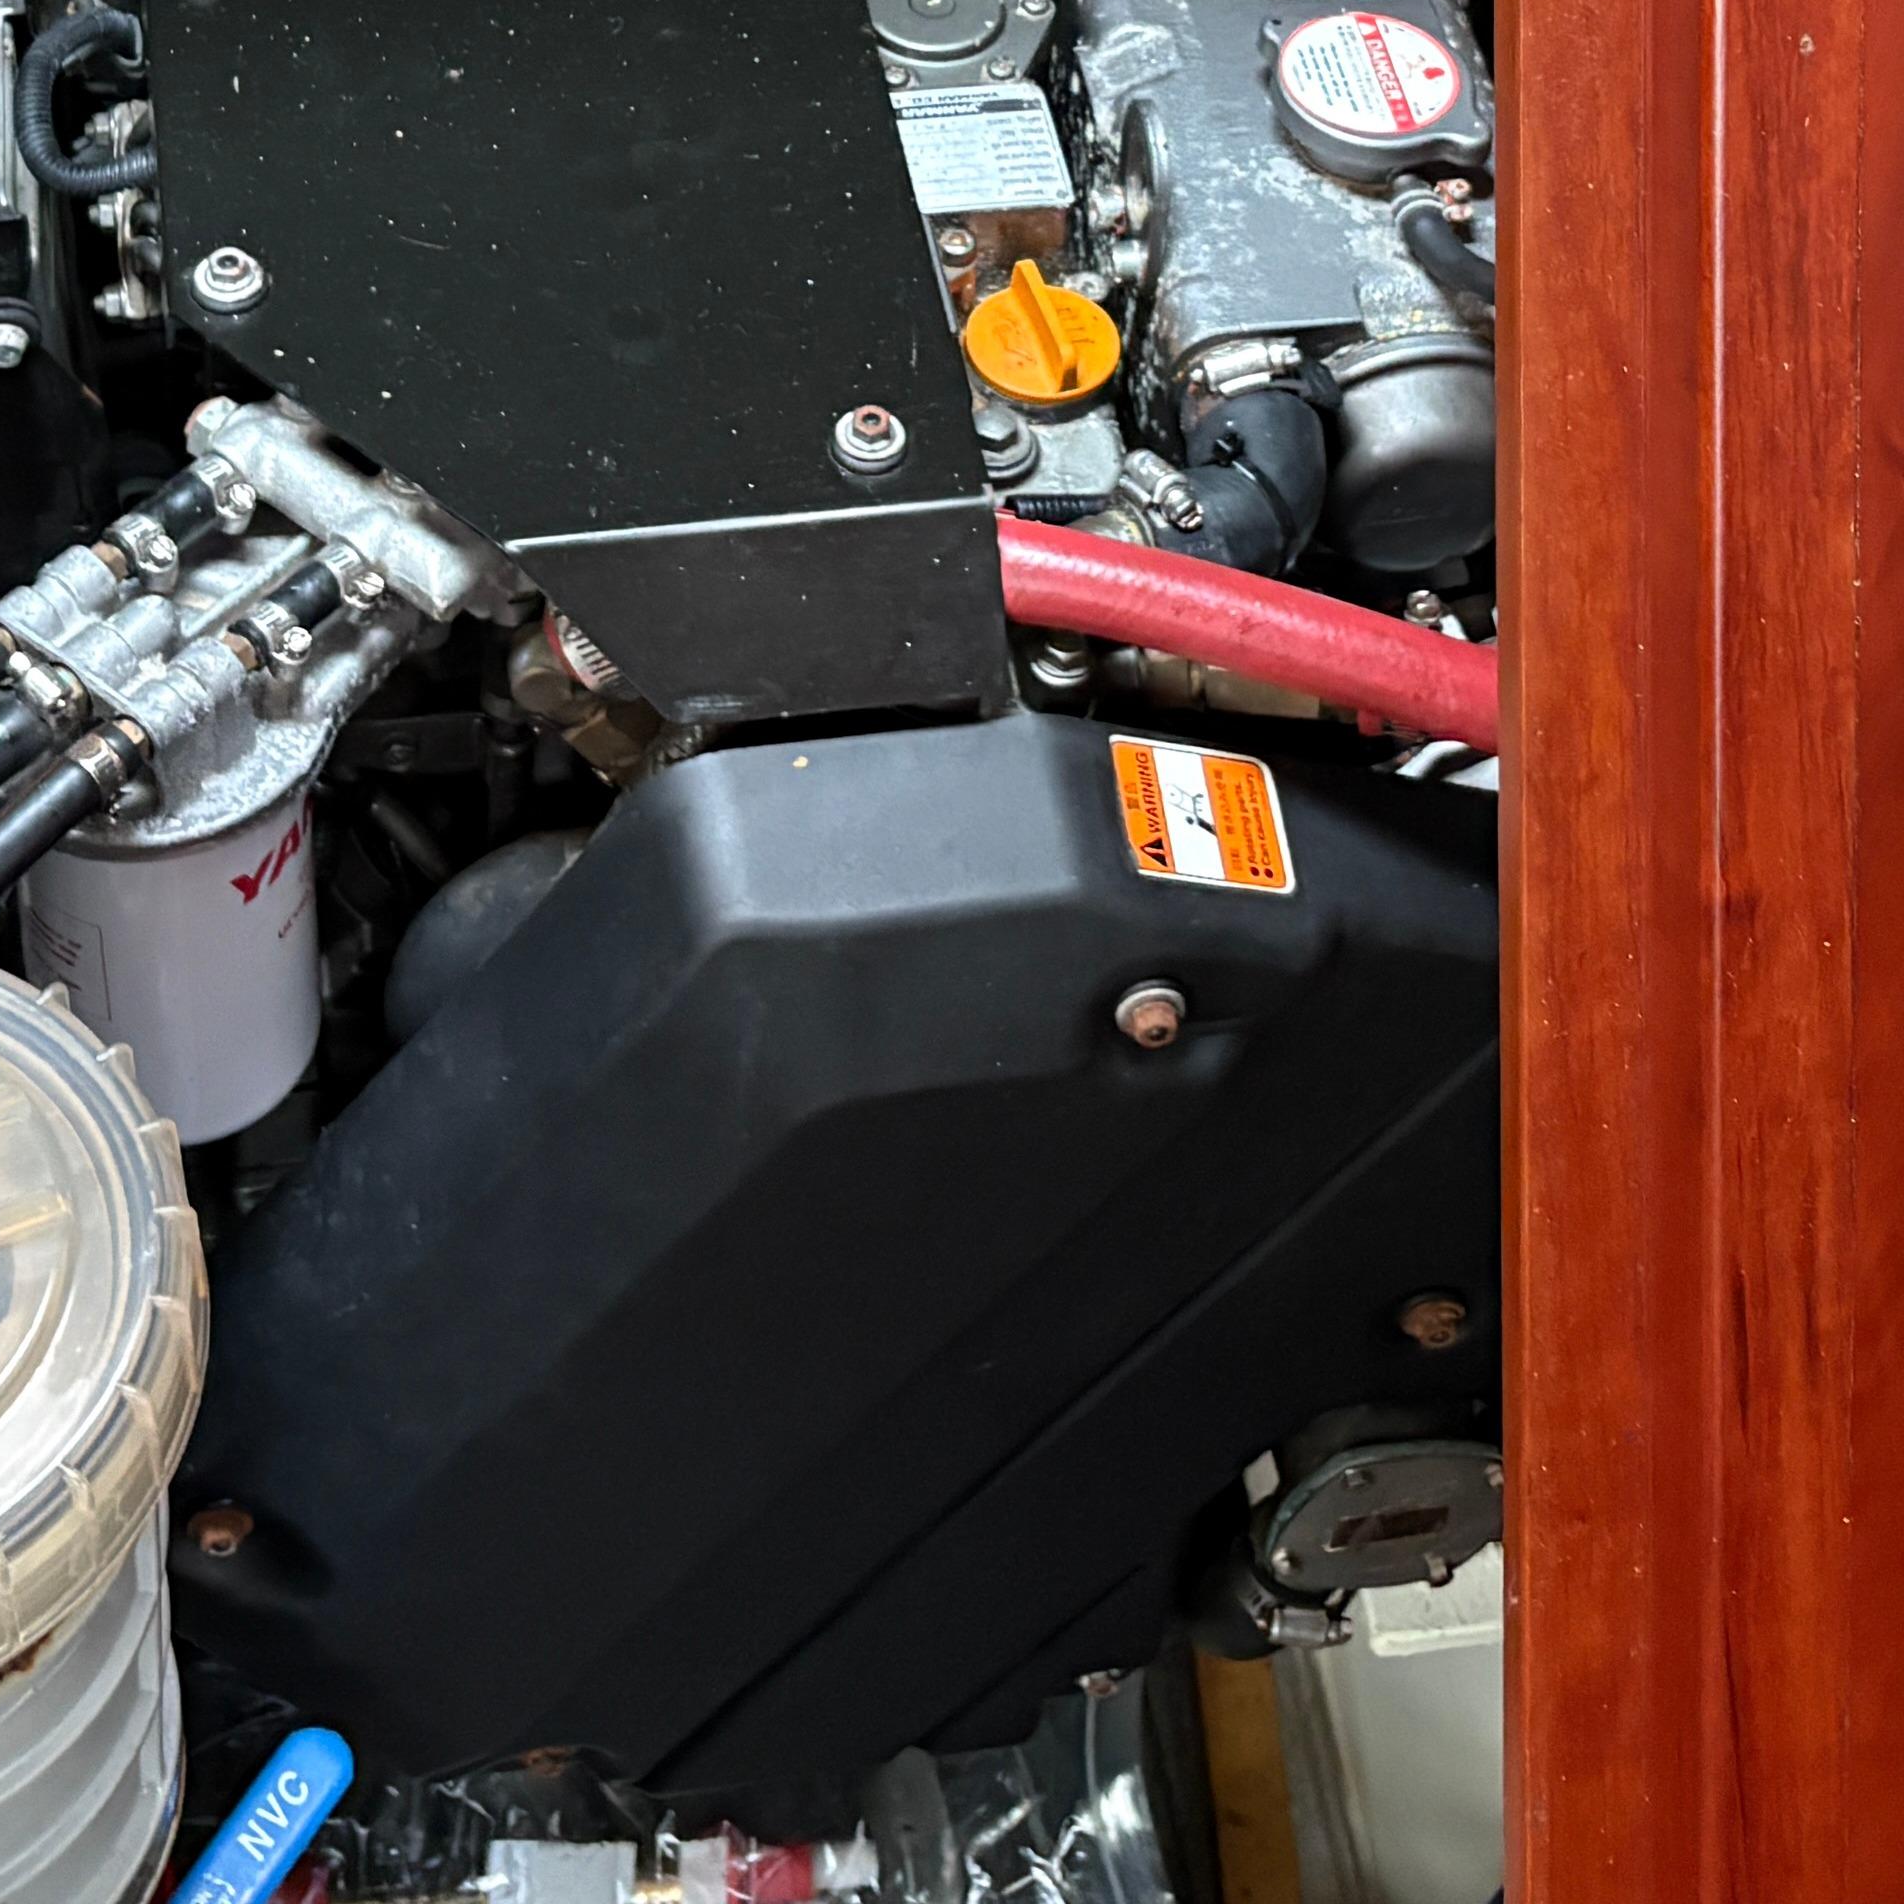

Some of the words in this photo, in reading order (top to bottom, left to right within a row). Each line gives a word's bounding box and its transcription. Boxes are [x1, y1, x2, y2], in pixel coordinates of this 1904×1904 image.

[1365, 39, 1404, 100] DANGER
[1135, 752, 1162, 834] WARNING
[1252, 808, 1266, 840] cause
[1258, 844, 1271, 866] Can
[236, 1770, 309, 1863] NVC
